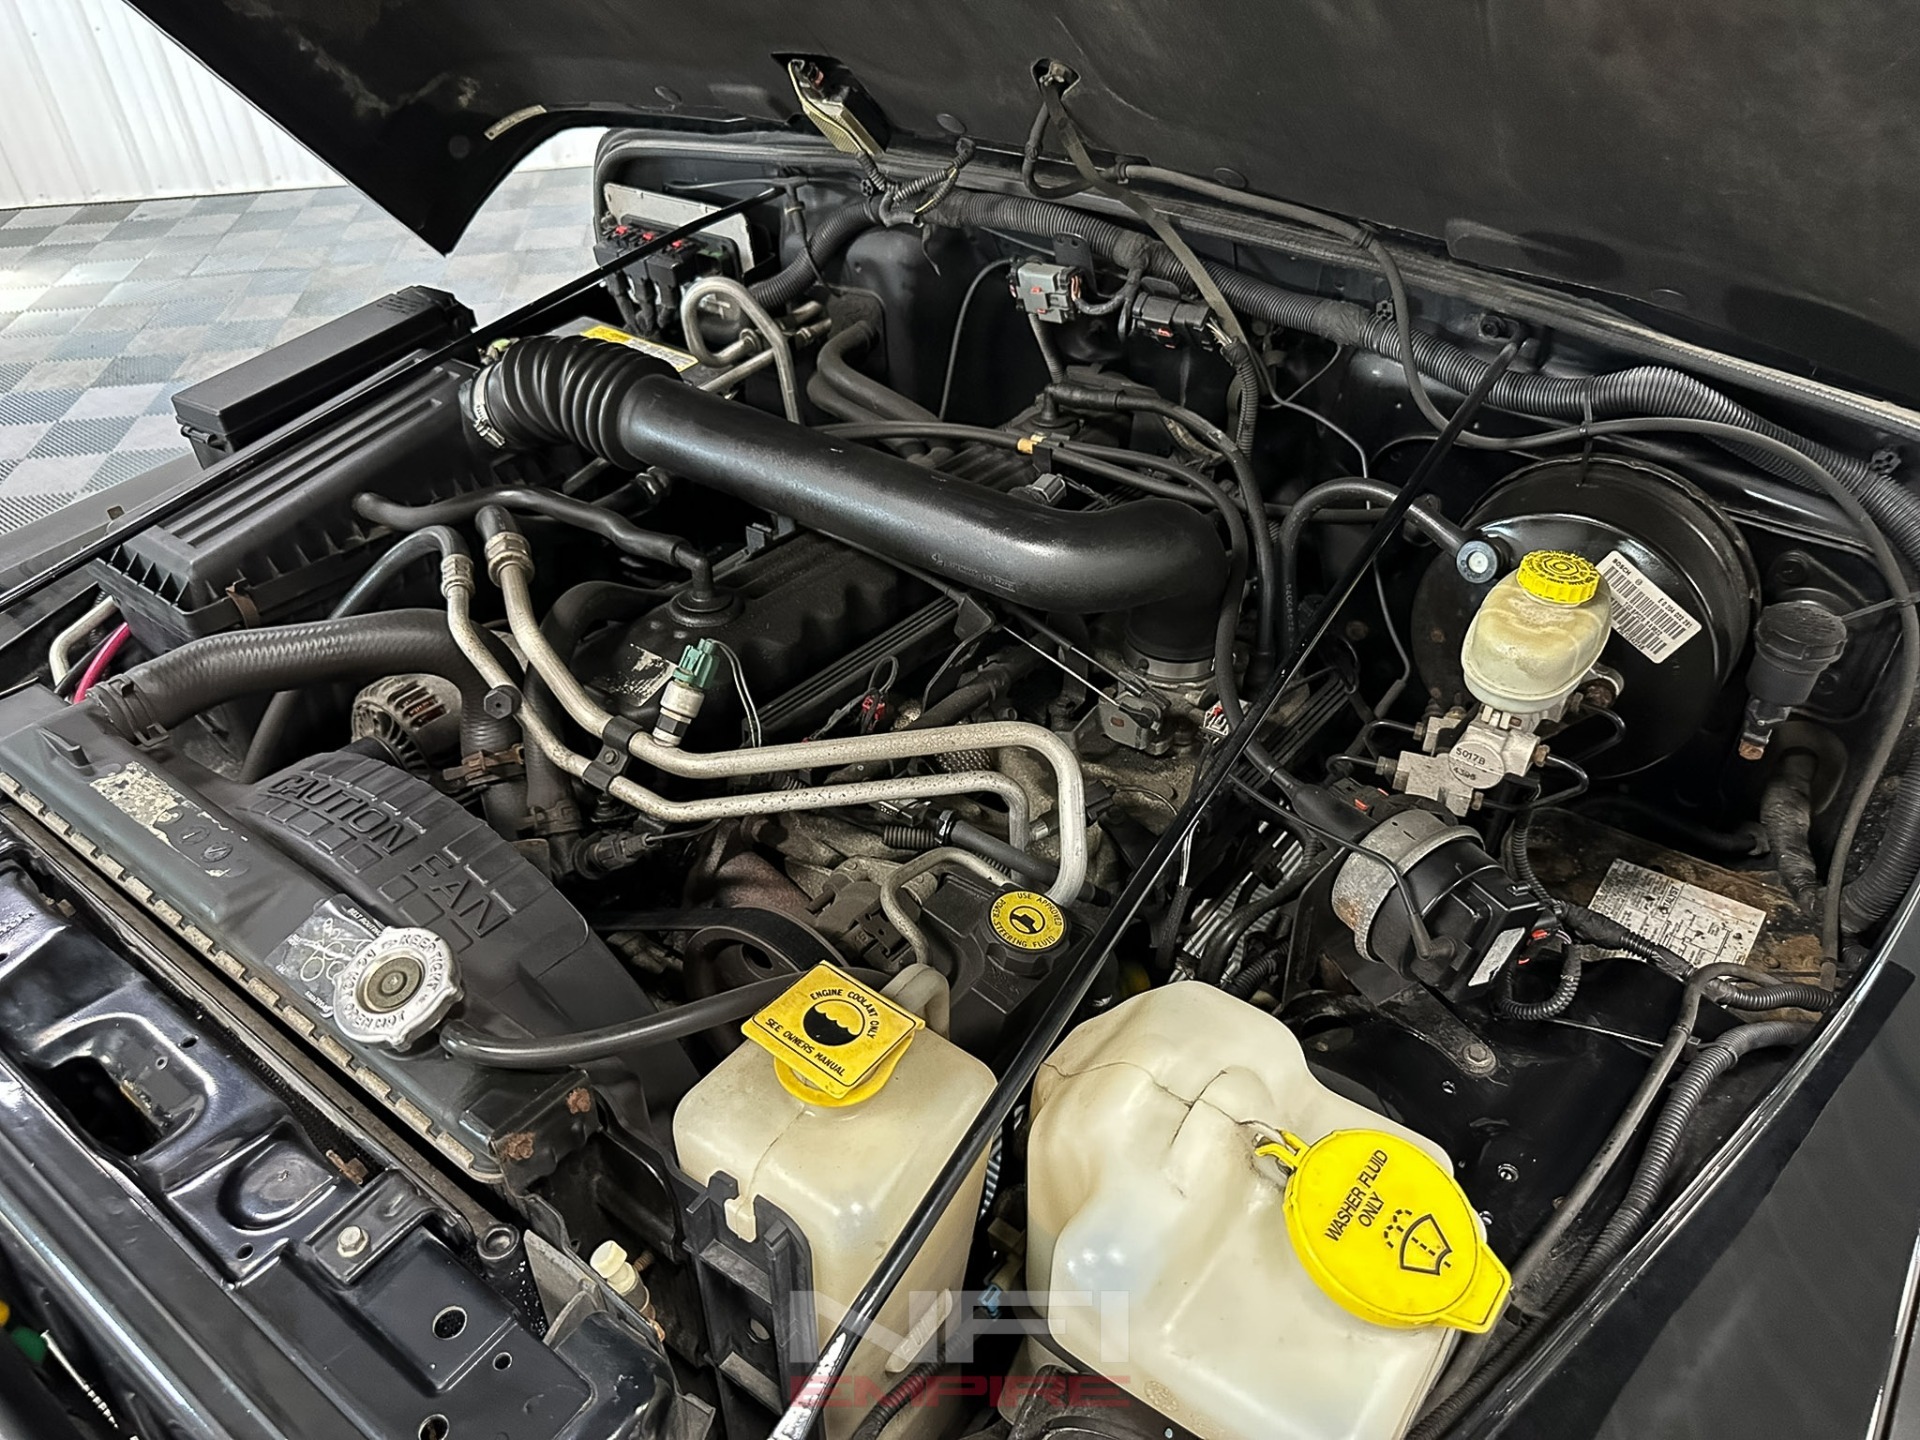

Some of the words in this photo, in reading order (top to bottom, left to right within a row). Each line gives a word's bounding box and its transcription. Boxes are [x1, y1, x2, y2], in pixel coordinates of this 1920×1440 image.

[1612, 558, 1632, 576] BOSCH
[268, 775, 418, 855] CAUTION
[408, 850, 512, 938] FAN
[993, 899, 1007, 918] POWER
[1017, 892, 1032, 900] USE
[1036, 896, 1063, 926] APPROVED
[994, 919, 1027, 947] STEERING
[1032, 935, 1056, 948] FLUID
[400, 934, 437, 950] KEEP
[427, 951, 443, 991] TIGHT
[810, 989, 844, 1000] ENGINE
[847, 991, 879, 1017] COOLANT
[867, 1020, 880, 1039] ONLY
[765, 1018, 784, 1032] SEE
[783, 1031, 815, 1053] OWNERS
[814, 1052, 846, 1077] MANUAL
[1325, 1186, 1367, 1242] WASHER
[1359, 1149, 1389, 1189] FLUID
[1357, 1191, 1385, 1228] ONLY
